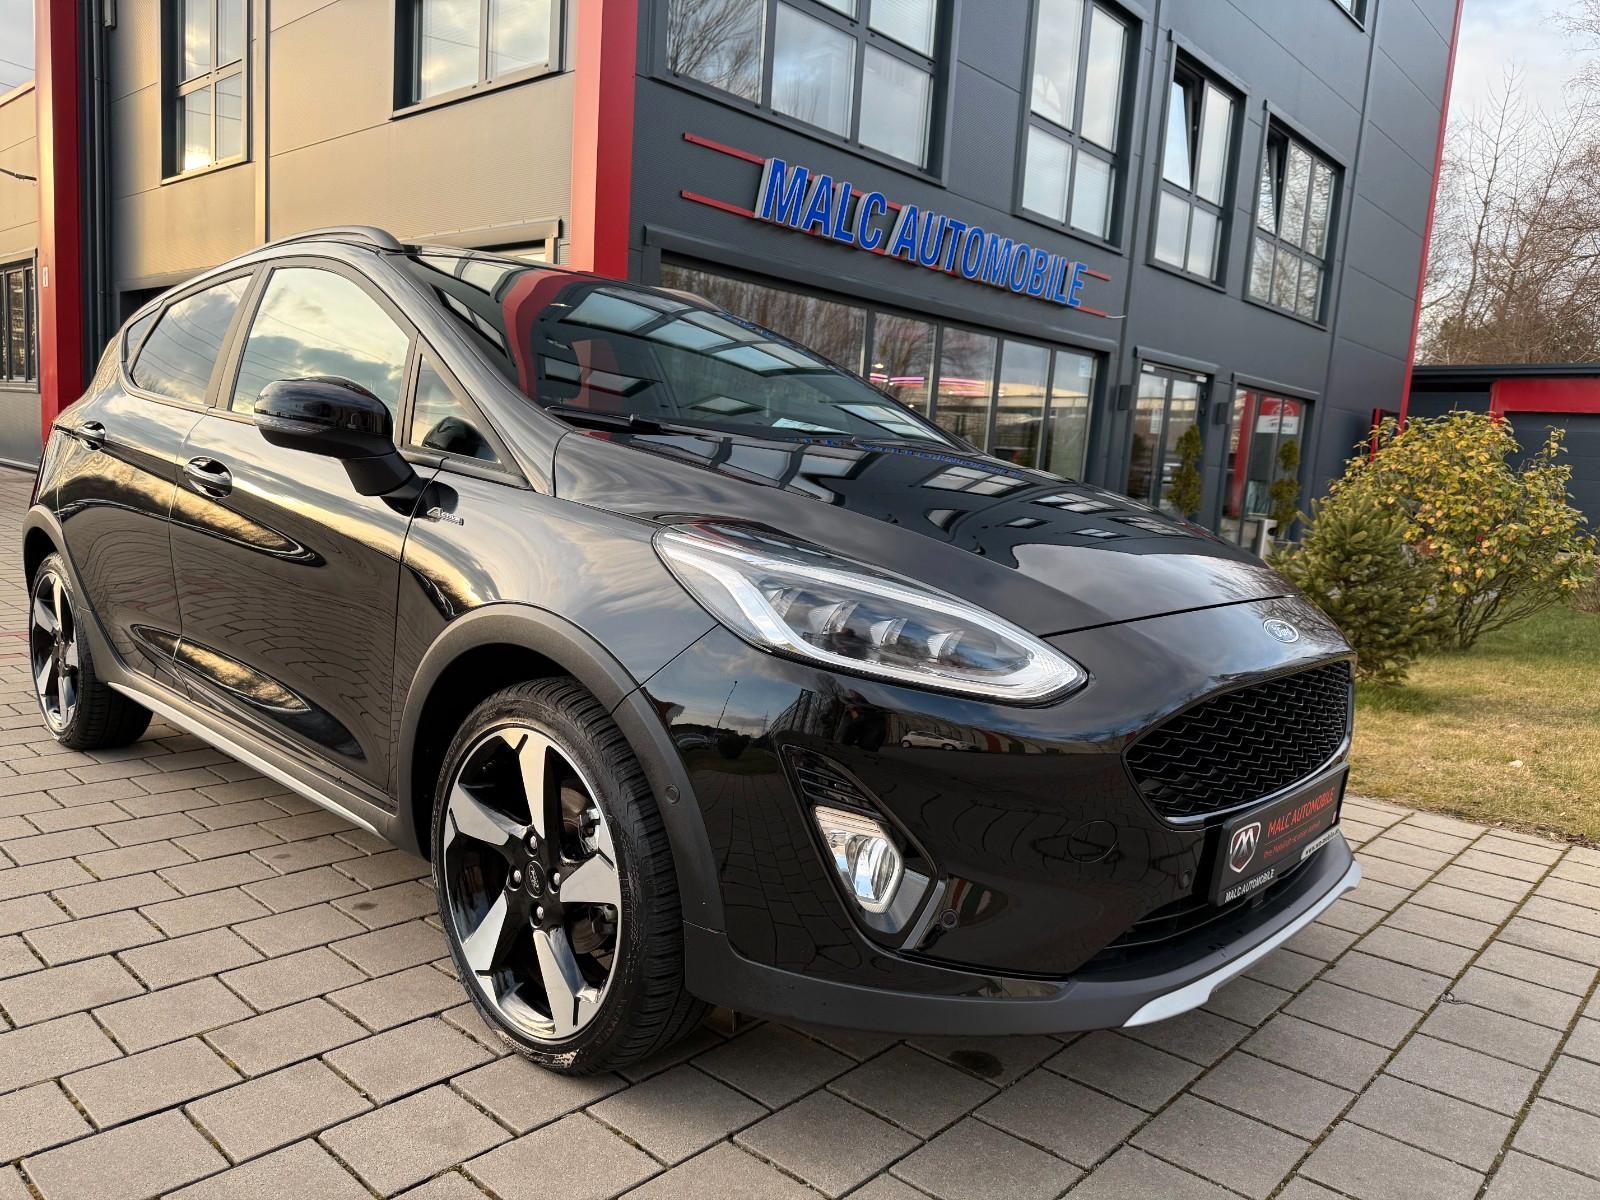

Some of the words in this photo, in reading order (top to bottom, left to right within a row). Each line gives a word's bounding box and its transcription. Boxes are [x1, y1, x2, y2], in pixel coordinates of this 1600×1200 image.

[759, 157, 888, 250] MALC
[889, 204, 1088, 307] AUTOMOBILE
[1267, 811, 1291, 838] MALC
[1291, 786, 1336, 825] AUTOMOBILE
[1224, 886, 1241, 903] MALC
[1241, 868, 1275, 895] AUTOMOBILE
